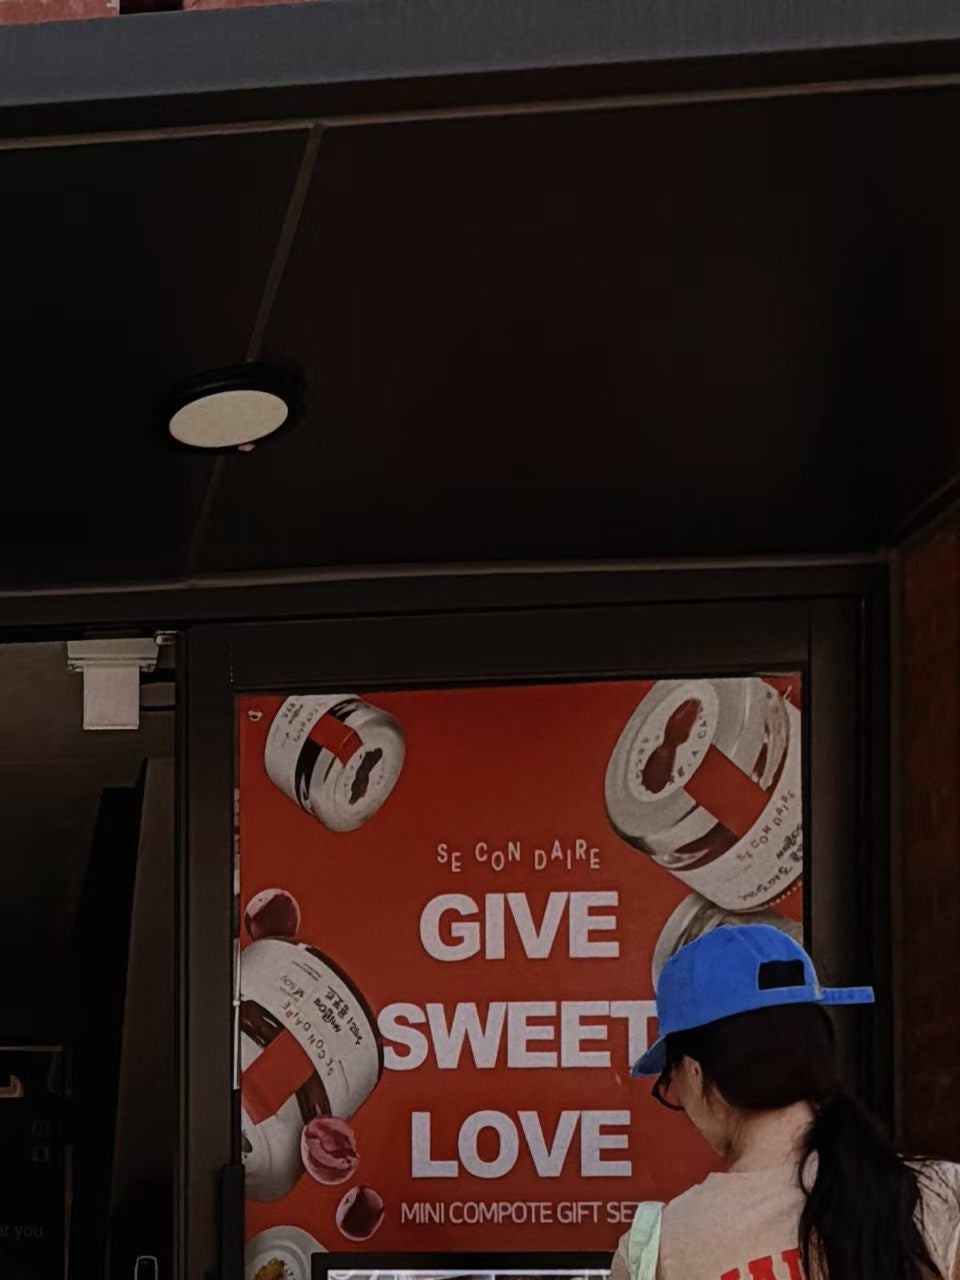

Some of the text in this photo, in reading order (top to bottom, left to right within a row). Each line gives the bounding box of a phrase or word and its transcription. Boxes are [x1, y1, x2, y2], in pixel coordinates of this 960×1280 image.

[437, 838, 601, 873] SE CON DAIRE
[419, 890, 620, 962] GIVE
[376, 1000, 657, 1070] SWEET
[411, 1109, 633, 1179] LOVE
[401, 1201, 639, 1224] MINI COMPOTE GIFT SE
